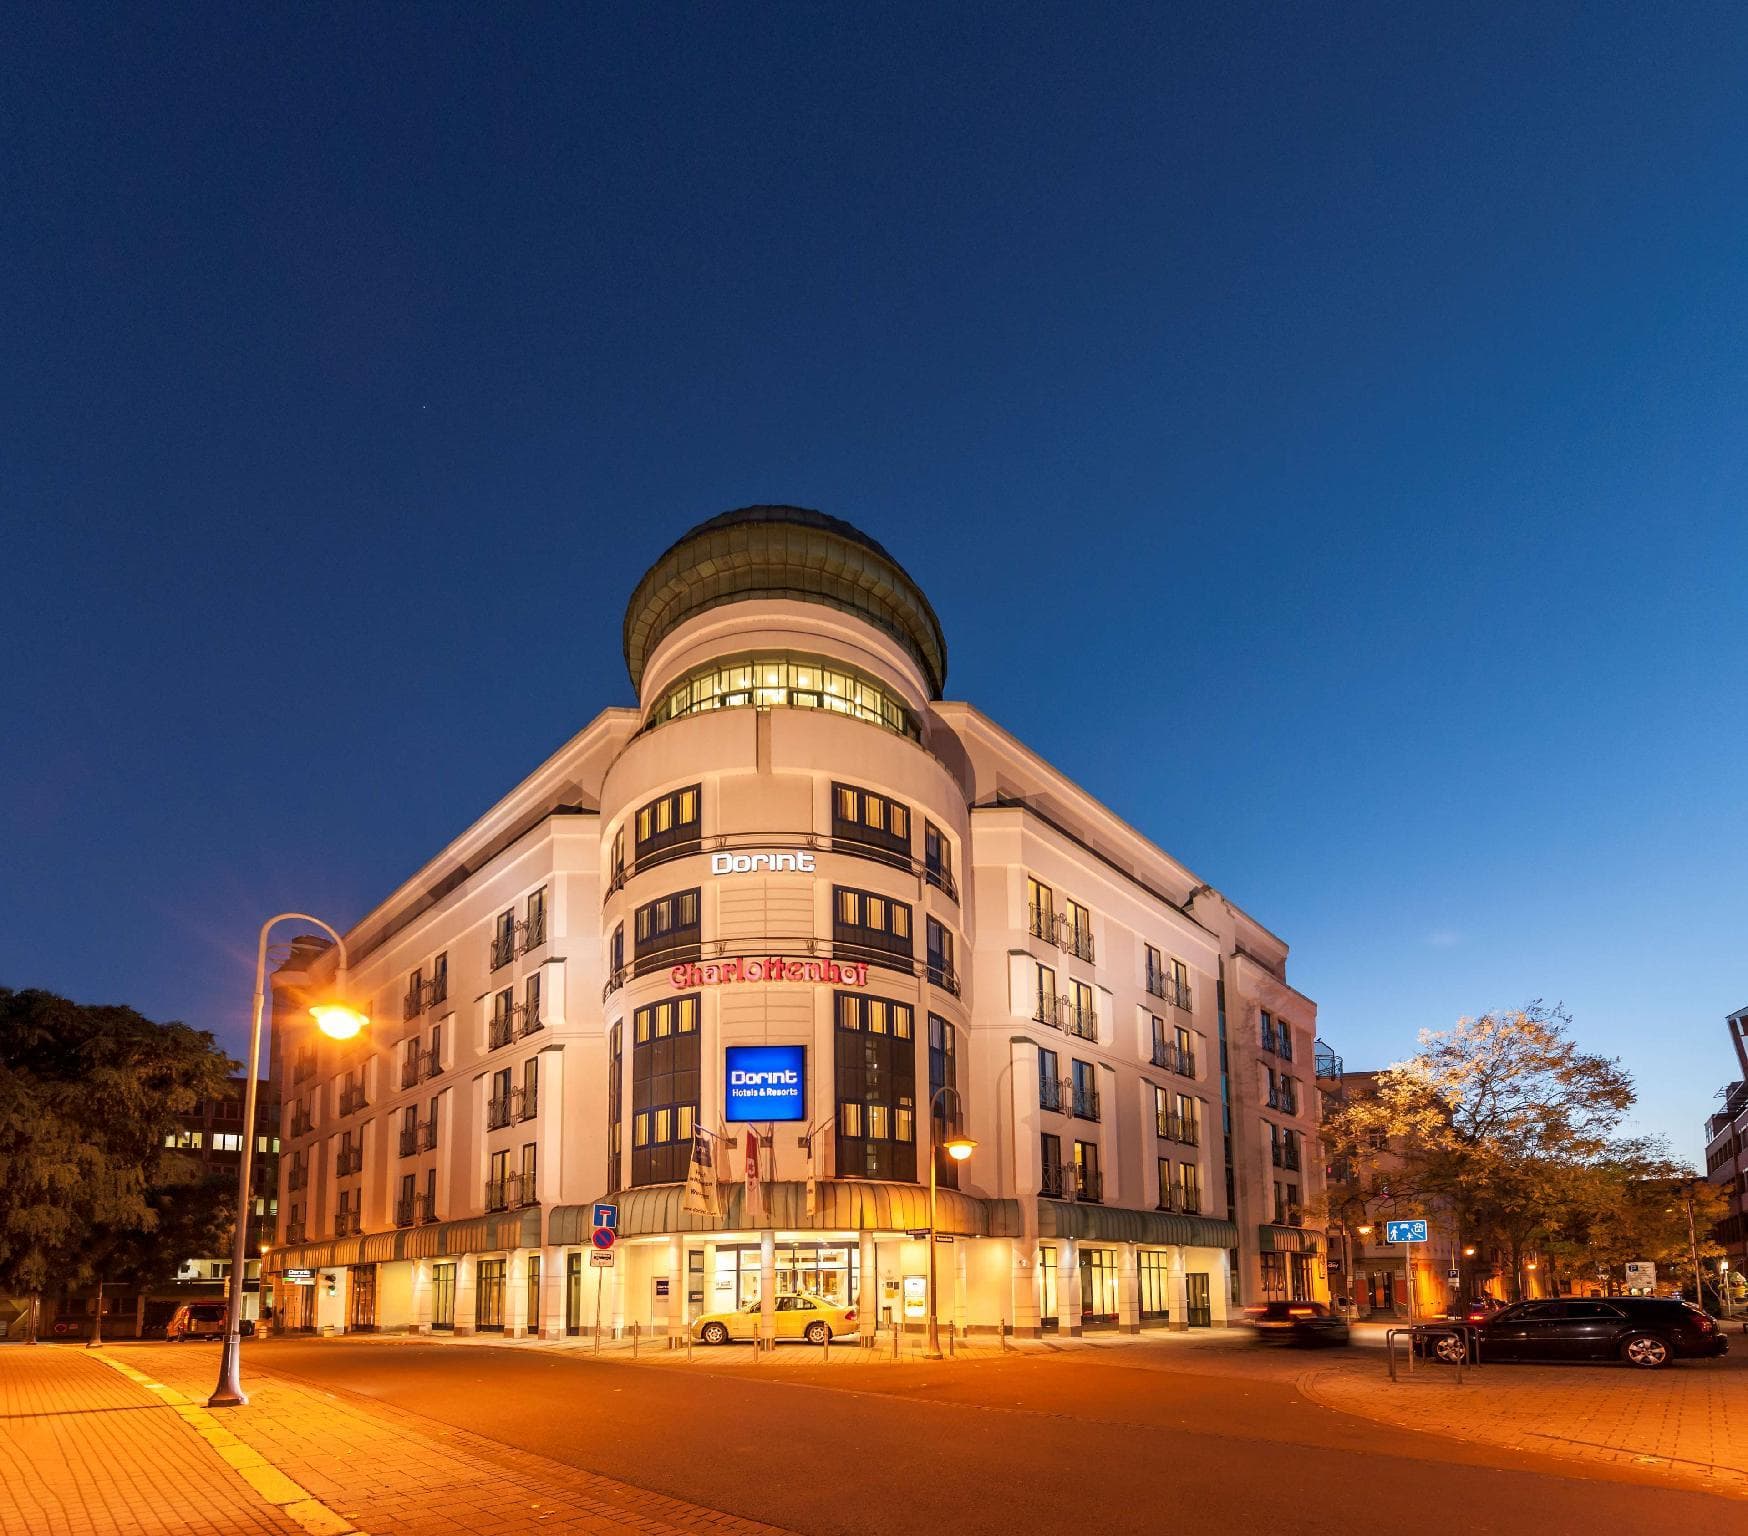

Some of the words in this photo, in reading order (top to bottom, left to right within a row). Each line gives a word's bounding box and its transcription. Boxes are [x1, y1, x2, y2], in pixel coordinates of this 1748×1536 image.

[711, 851, 816, 875] Dorint
[670, 956, 868, 989] Charlottenhof
[731, 1069, 798, 1085] Dorint
[732, 1088, 758, 1097] Hotels
[758, 1087, 766, 1097] &
[766, 1087, 798, 1097] Resorts
[1449, 1270, 1457, 1278] P
